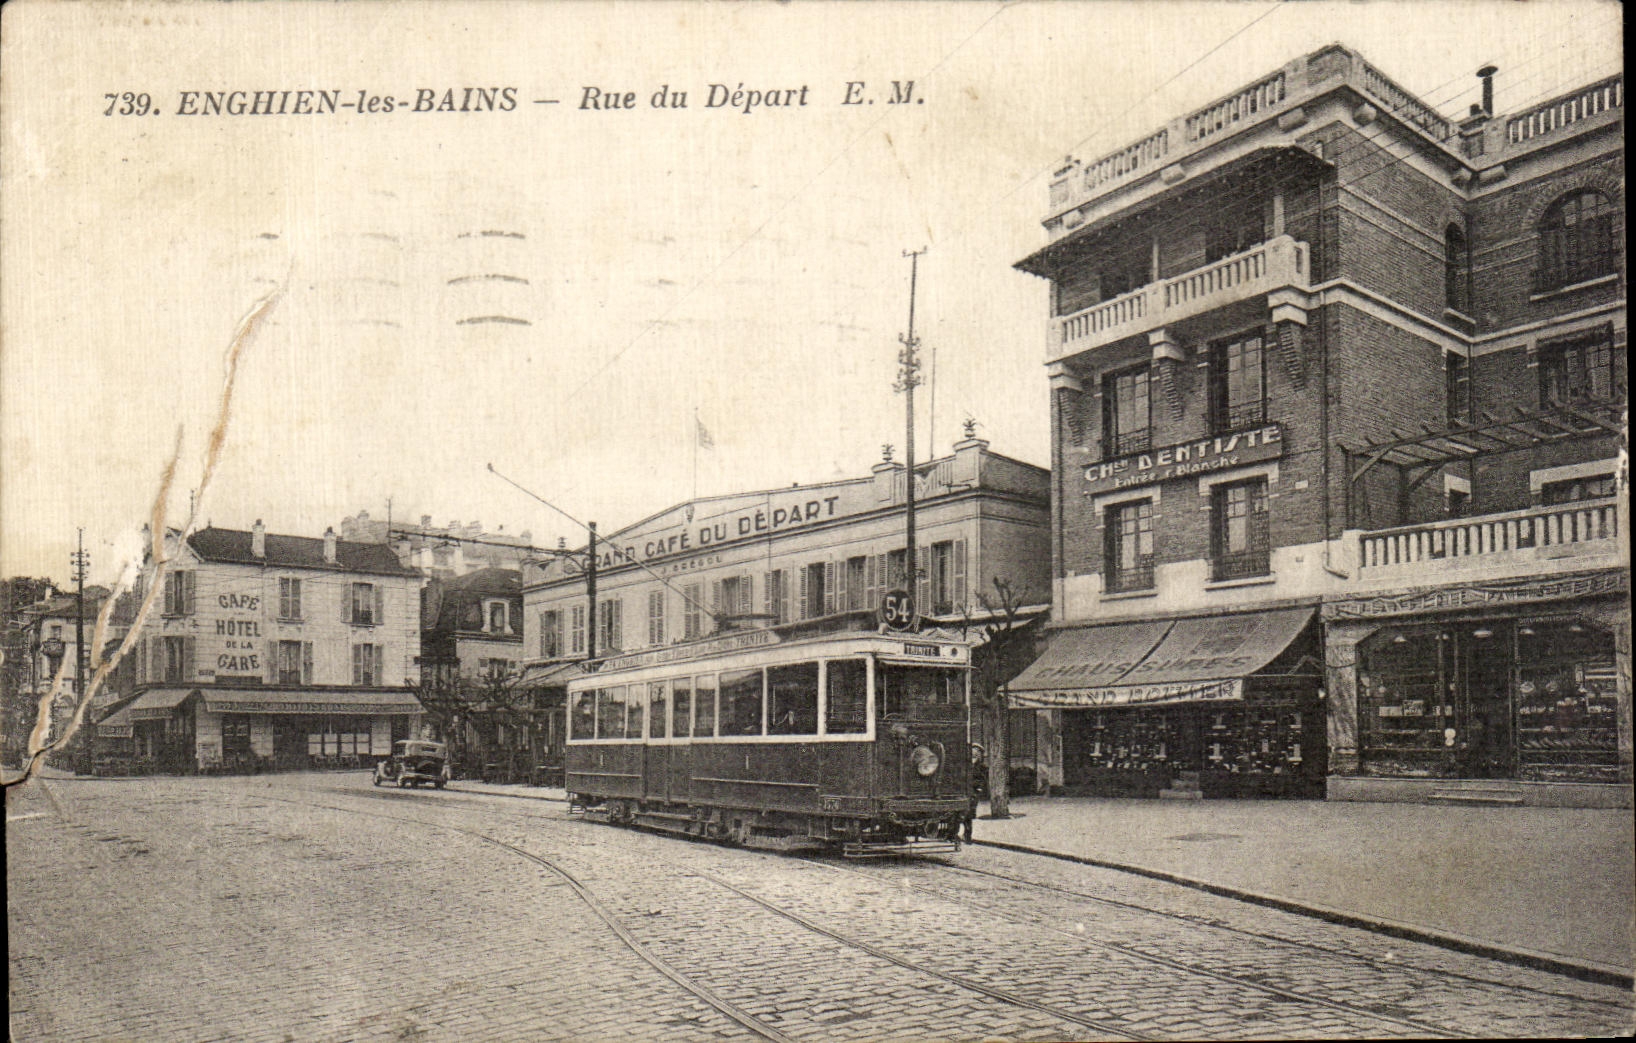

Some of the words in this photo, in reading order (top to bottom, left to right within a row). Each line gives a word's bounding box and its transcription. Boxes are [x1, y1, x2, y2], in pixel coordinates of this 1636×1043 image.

[1138, 424, 1282, 471] DENTISTE
[644, 528, 691, 558] CAFÉ
[699, 522, 728, 546] DU
[738, 495, 840, 536] DÉPART
[885, 595, 910, 623] 54
[226, 640, 238, 649] DE
[240, 641, 254, 650] LA
[217, 653, 261, 671] GARE
